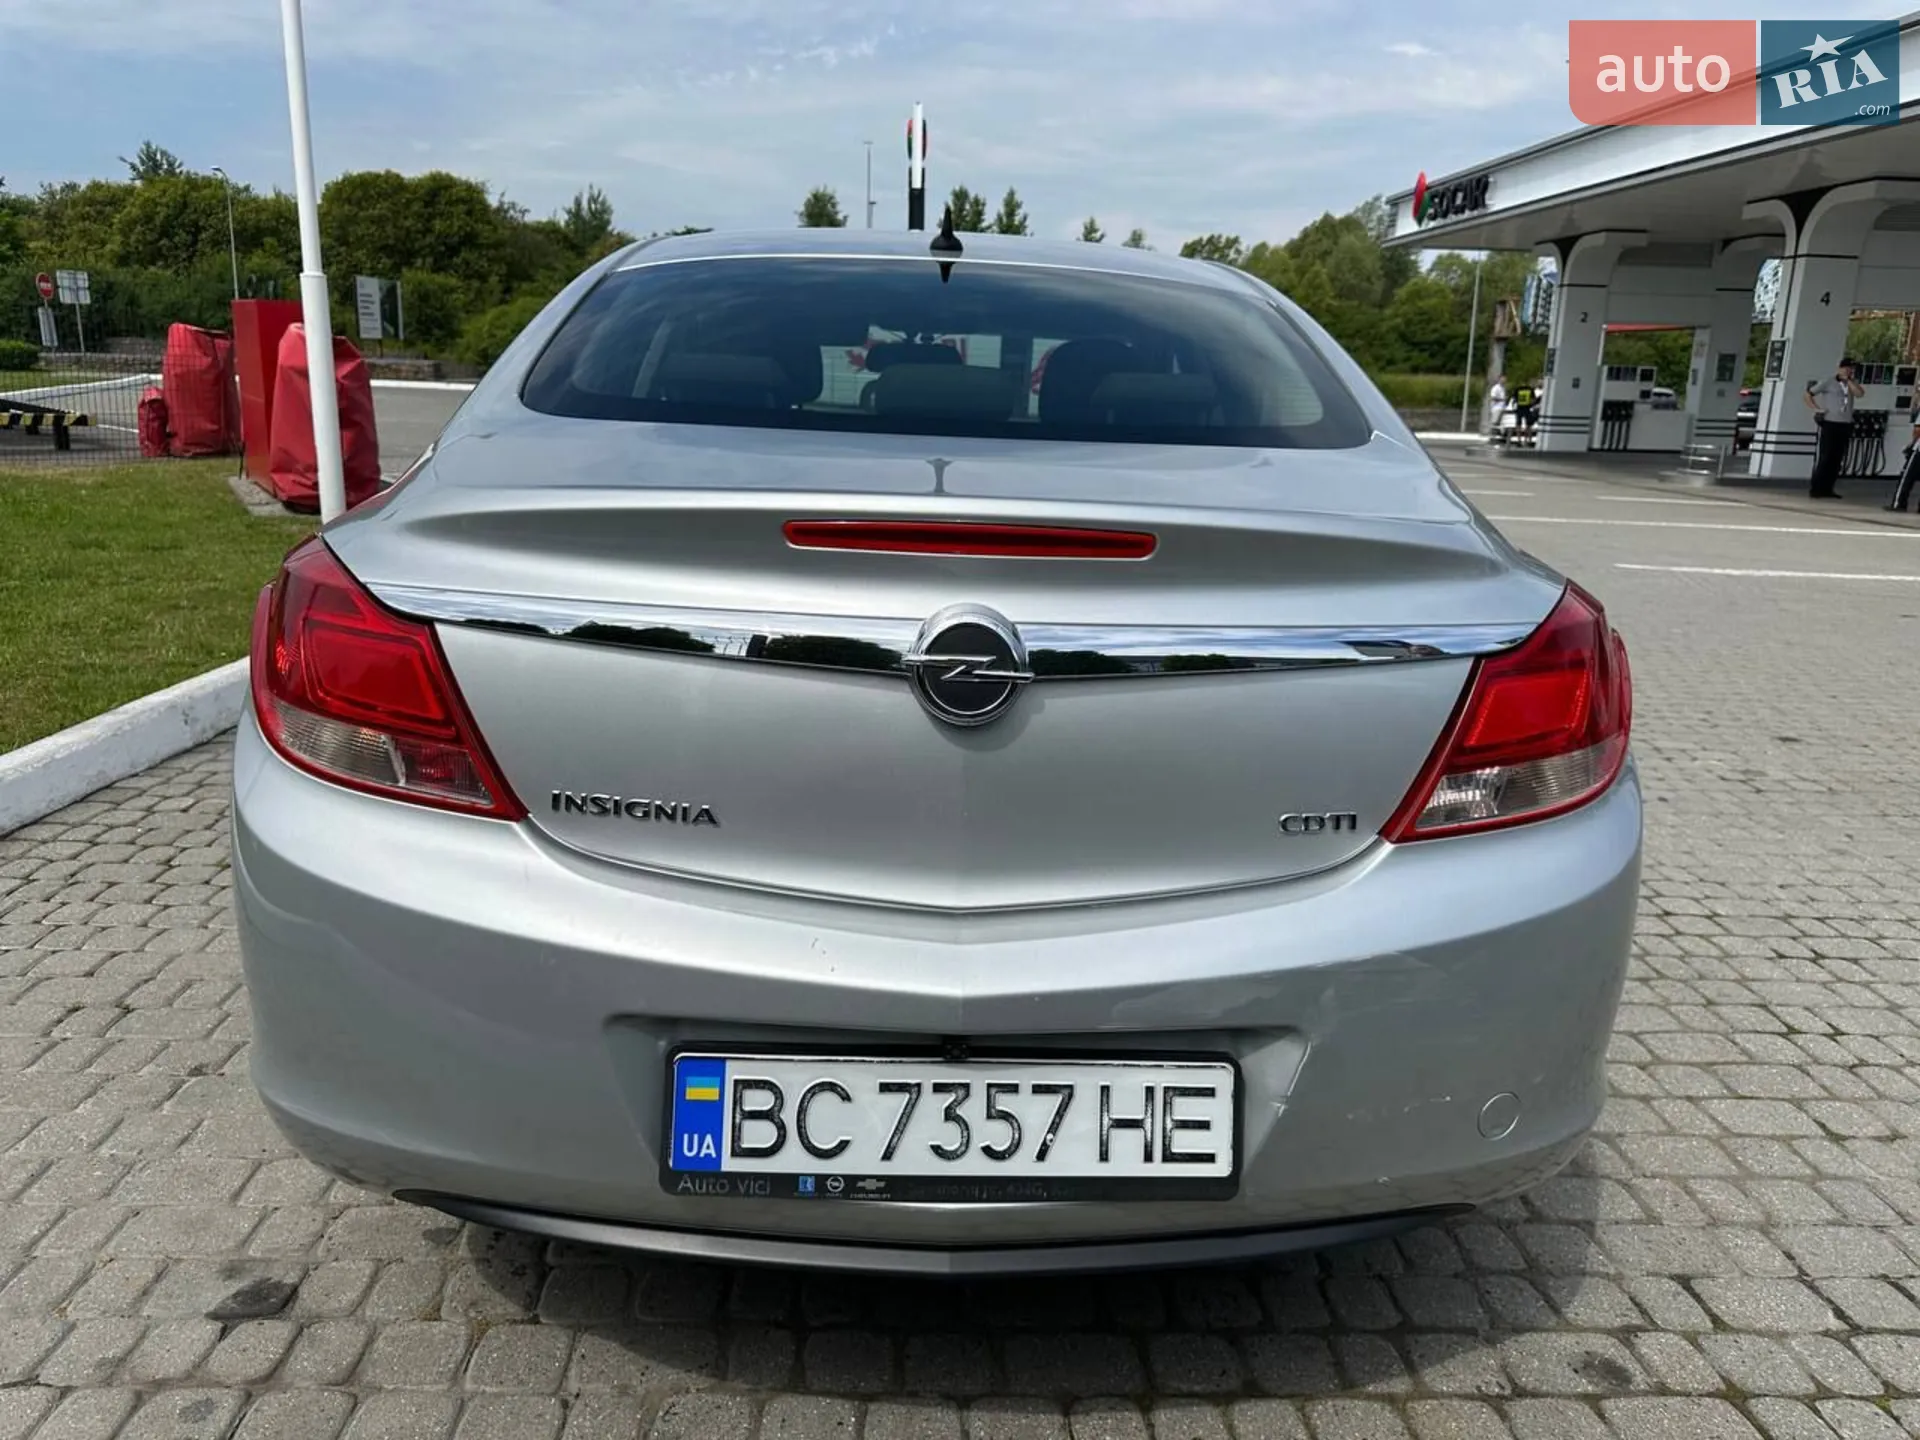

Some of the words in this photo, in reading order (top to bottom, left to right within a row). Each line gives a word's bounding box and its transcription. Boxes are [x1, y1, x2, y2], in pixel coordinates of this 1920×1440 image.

[1820, 291, 1831, 307] 4
[1580, 311, 1588, 324] 2
[551, 789, 720, 827] INSIGNIA
[1279, 812, 1357, 834] CDTI
[730, 1075, 853, 1160] BC
[878, 1079, 1075, 1163] 7357
[1098, 1081, 1217, 1164] HE
[683, 1133, 718, 1158] UA
[676, 1173, 730, 1195] Auto
